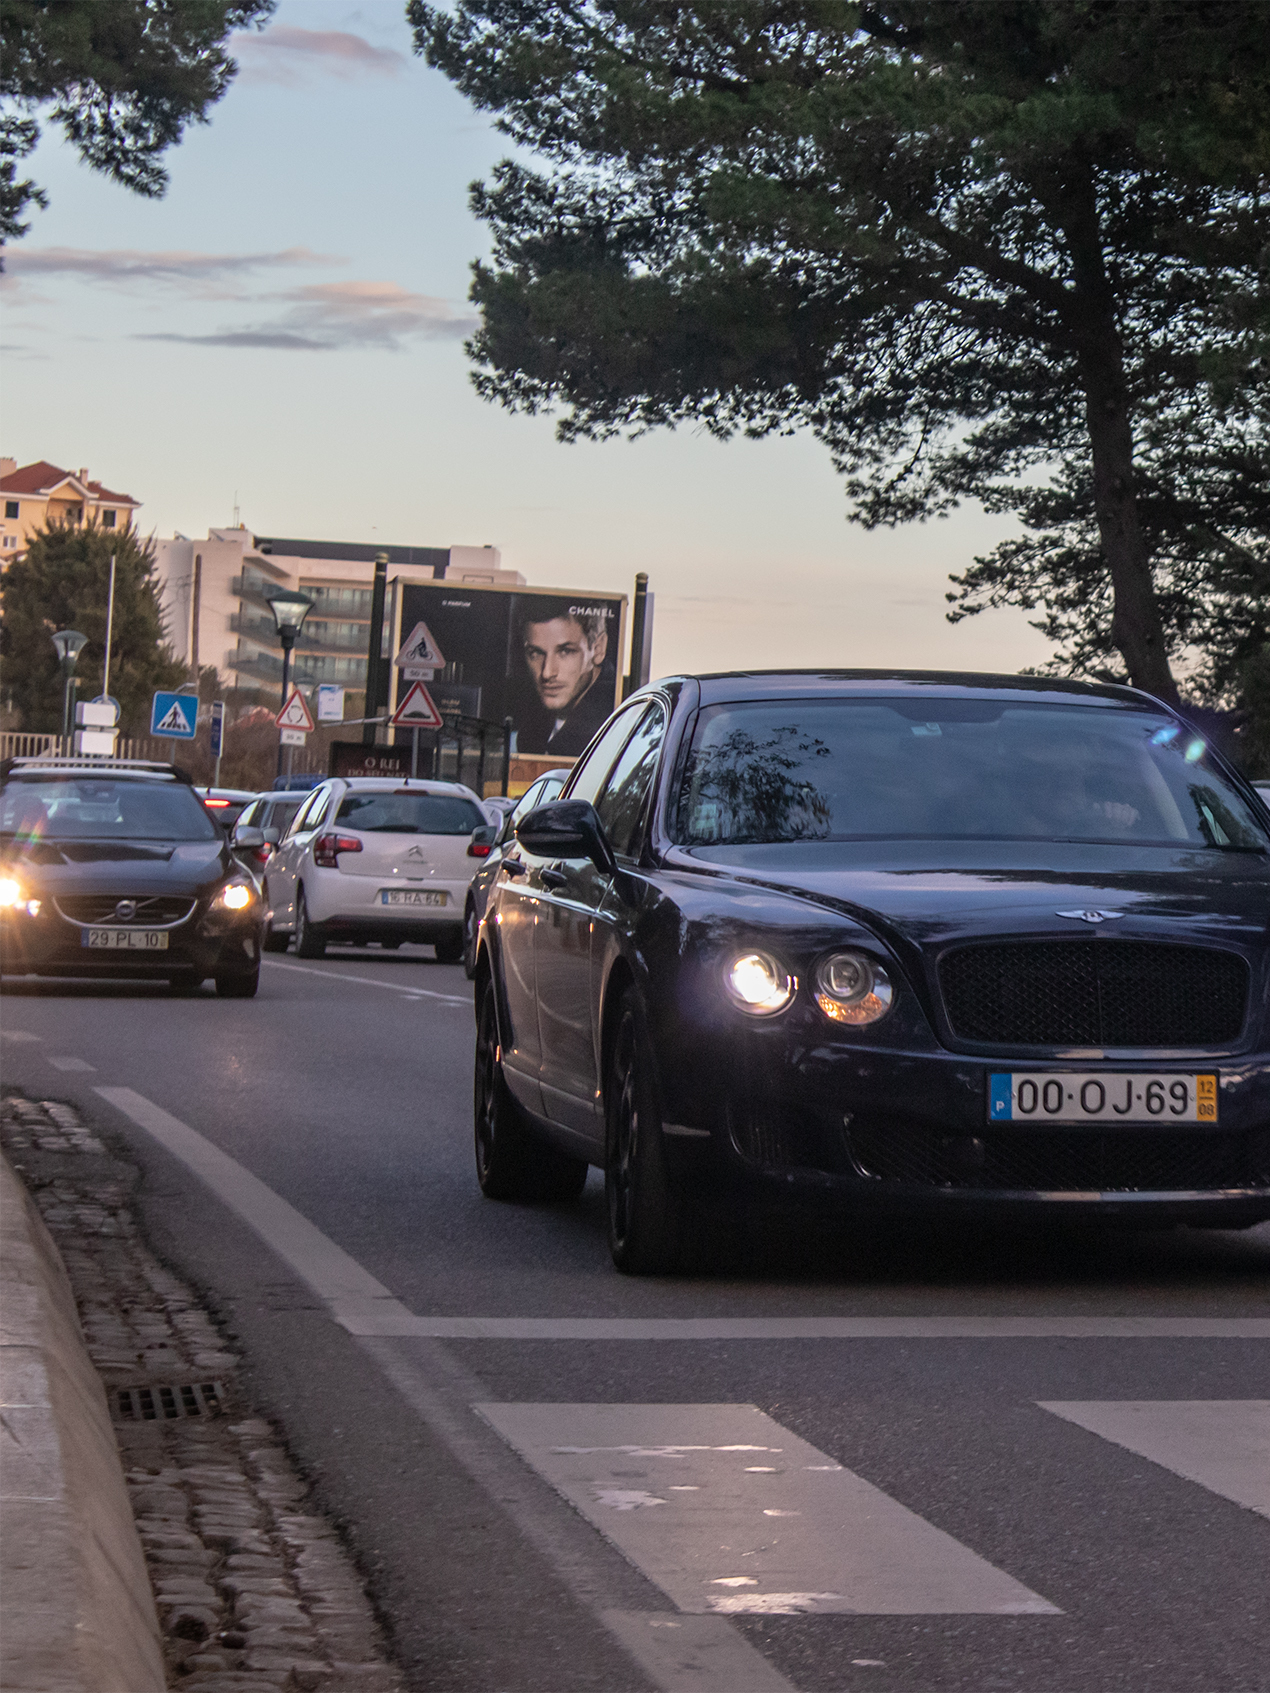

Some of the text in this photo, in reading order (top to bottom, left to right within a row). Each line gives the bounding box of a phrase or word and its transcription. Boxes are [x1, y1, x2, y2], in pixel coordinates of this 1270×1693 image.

[568, 605, 615, 619] CHANEL
[364, 756, 400, 770] O REI
[1199, 1080, 1215, 1094] 12
